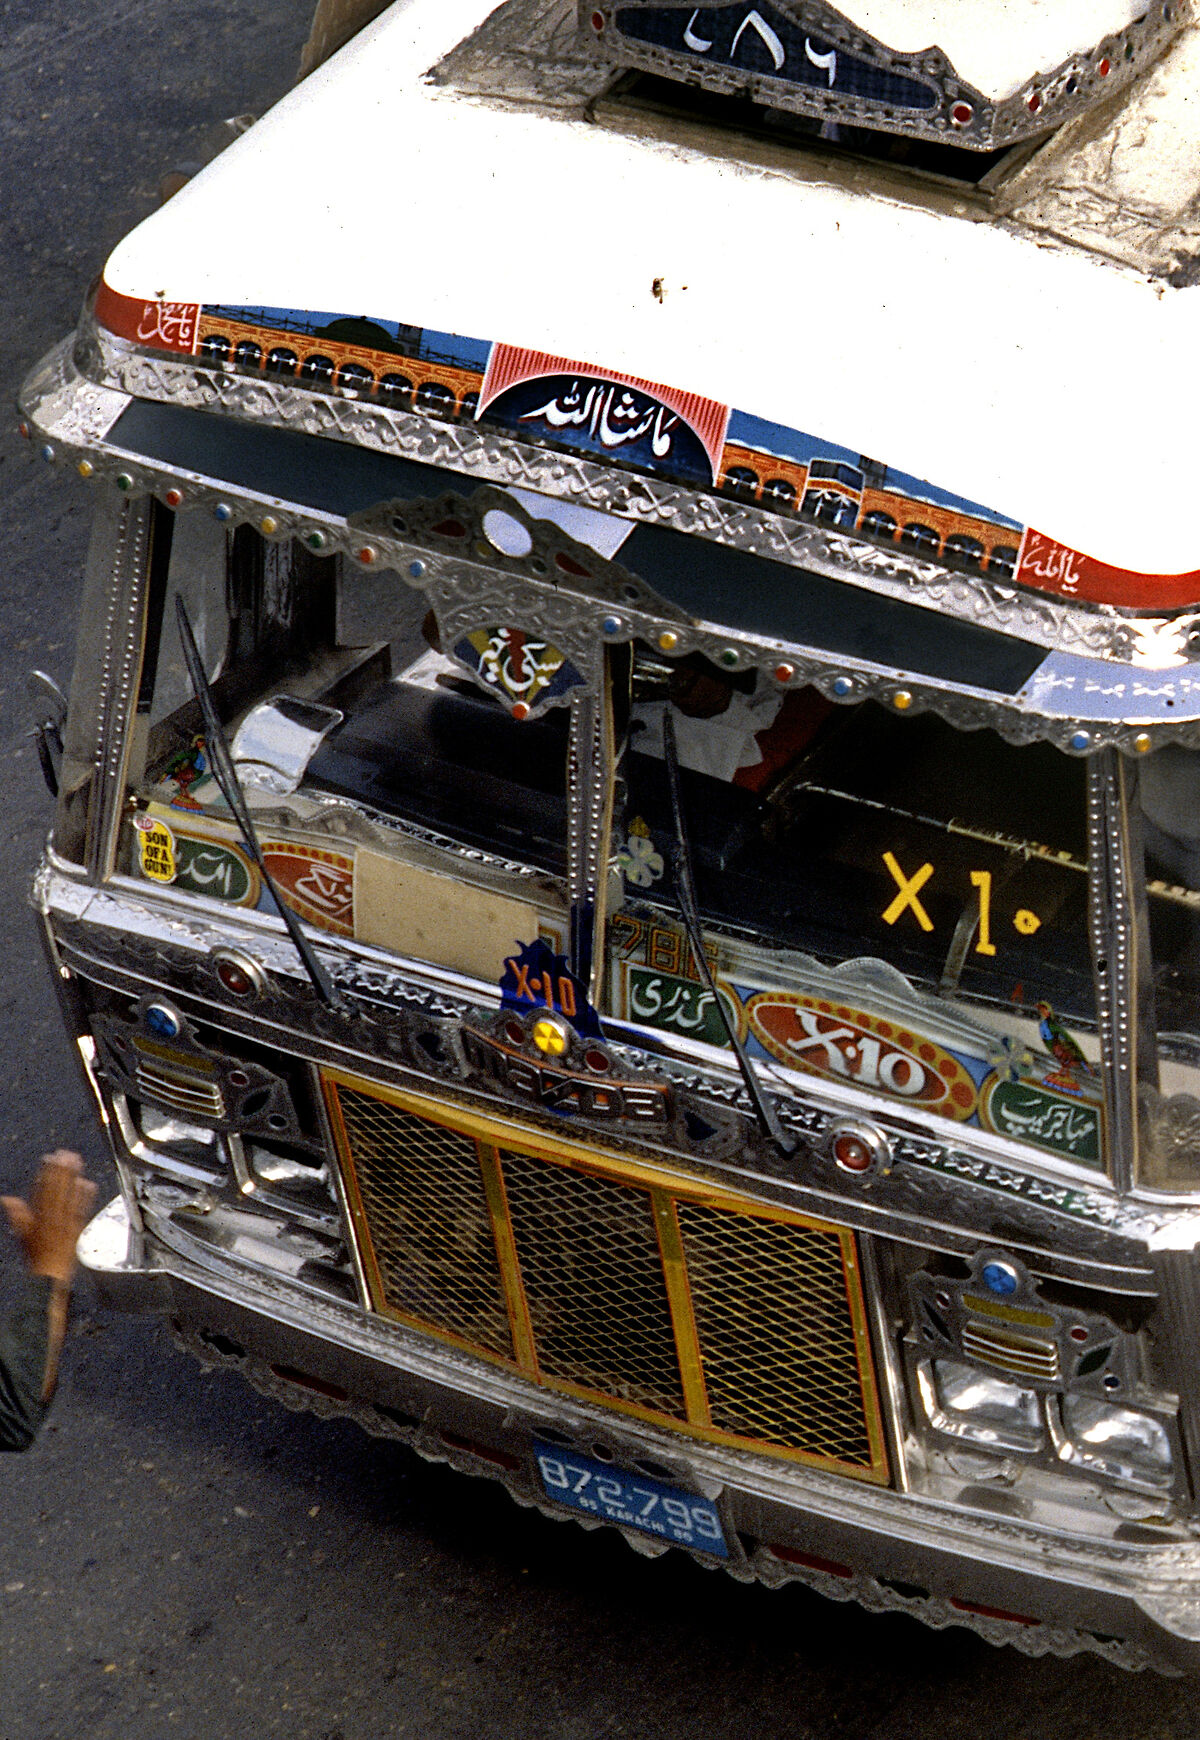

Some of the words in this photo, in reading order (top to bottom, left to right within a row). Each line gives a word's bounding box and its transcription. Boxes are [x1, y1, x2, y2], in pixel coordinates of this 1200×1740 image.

[145, 831, 168, 847] SON
[146, 845, 160, 859] OF
[161, 849, 169, 862] A
[612, 914, 718, 985] 786
[605, 1506, 665, 1533] KARACHI
